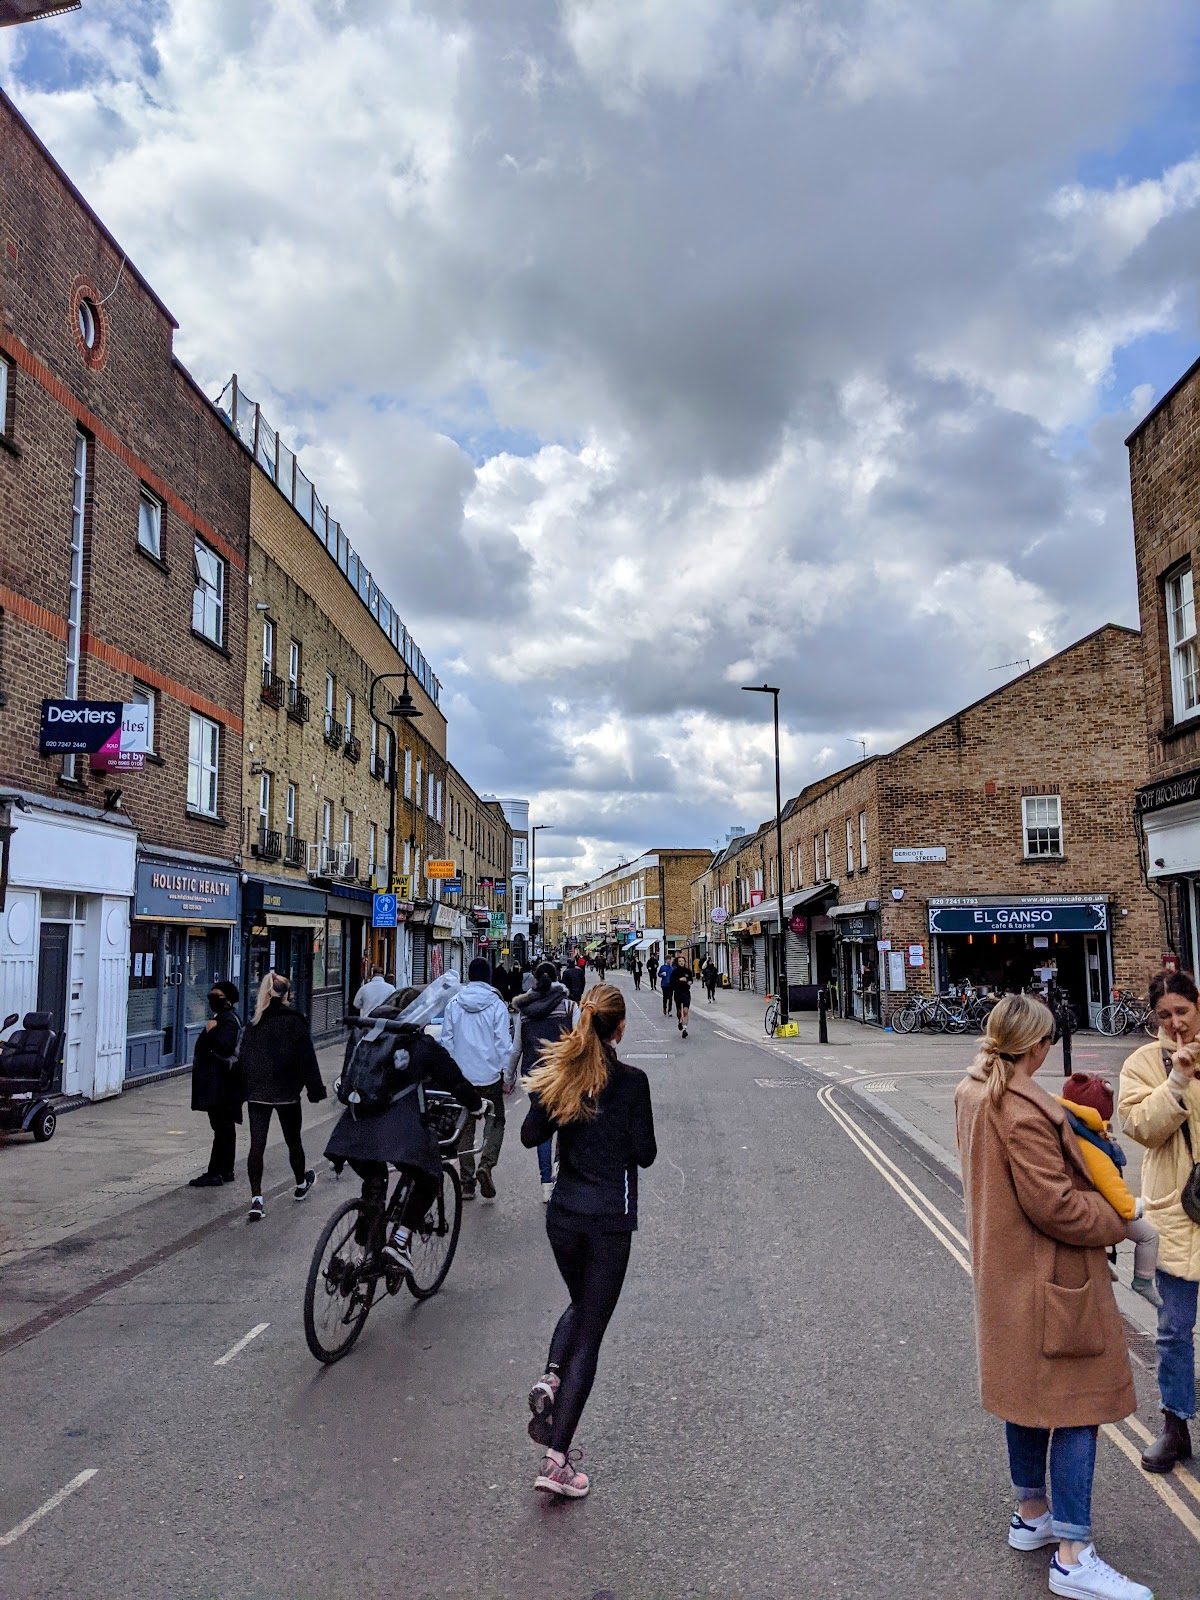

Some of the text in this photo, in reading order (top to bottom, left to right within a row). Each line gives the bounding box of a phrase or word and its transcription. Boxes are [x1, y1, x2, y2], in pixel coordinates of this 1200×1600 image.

[48, 706, 115, 724] Dexters
[46, 740, 57, 748] 020
[73, 741, 87, 749] 2440
[119, 752, 144, 763] let by
[1141, 790, 1154, 808] OFF
[153, 873, 230, 896] HOLISTIC HEALTH
[1020, 895, 1104, 904] www.elgansocafe.co.uk
[974, 909, 1053, 923] EL GANSO
[1014, 922, 1035, 930] tapas
